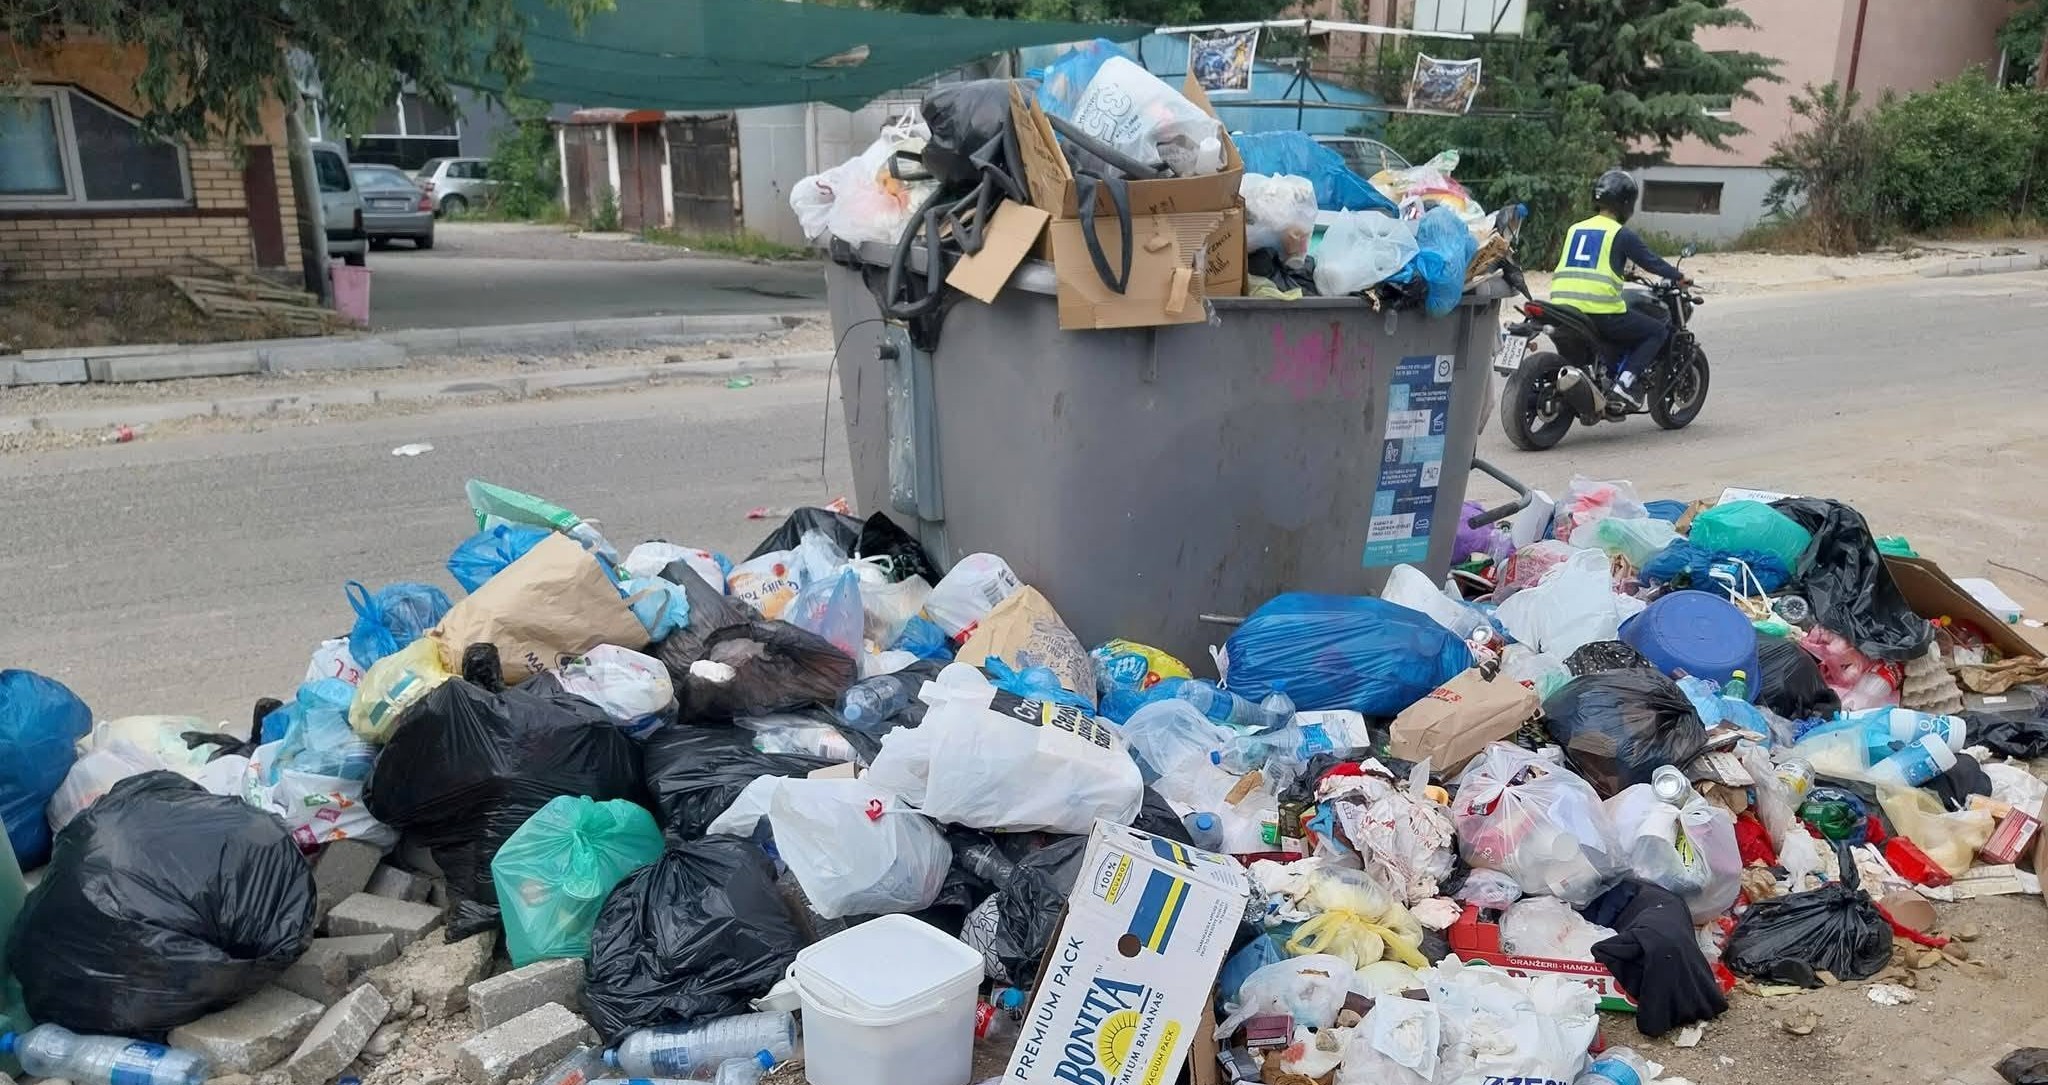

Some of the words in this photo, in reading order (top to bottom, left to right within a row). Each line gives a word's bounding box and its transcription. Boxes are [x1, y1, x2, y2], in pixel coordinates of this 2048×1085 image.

[1573, 235, 1590, 261] L
[1101, 862, 1116, 889] 100%
[1015, 992, 1061, 1080] PREMIUM
[1054, 936, 1084, 986] PACK
[1136, 991, 1164, 1048] BANANAS
[1053, 977, 1145, 1085] BONITA
[1161, 1030, 1174, 1052] PACK
